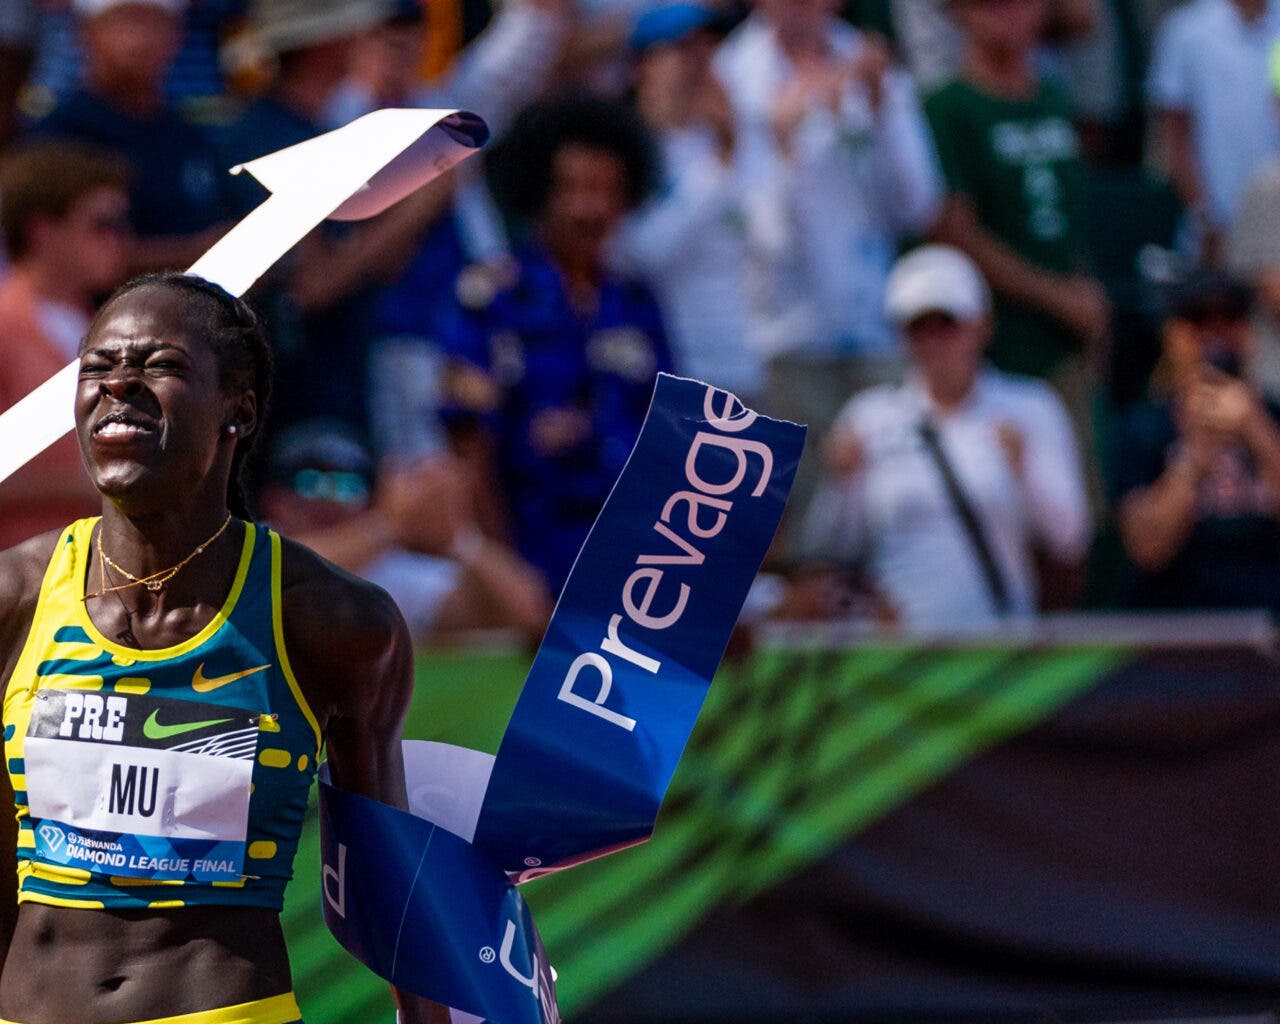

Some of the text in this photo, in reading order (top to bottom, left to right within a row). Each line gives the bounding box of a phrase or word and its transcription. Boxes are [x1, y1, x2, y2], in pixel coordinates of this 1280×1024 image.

[59, 693, 128, 742] PRE
[108, 763, 160, 818] MU
[65, 843, 236, 873] DIAMOND LEAGUE FINAL
